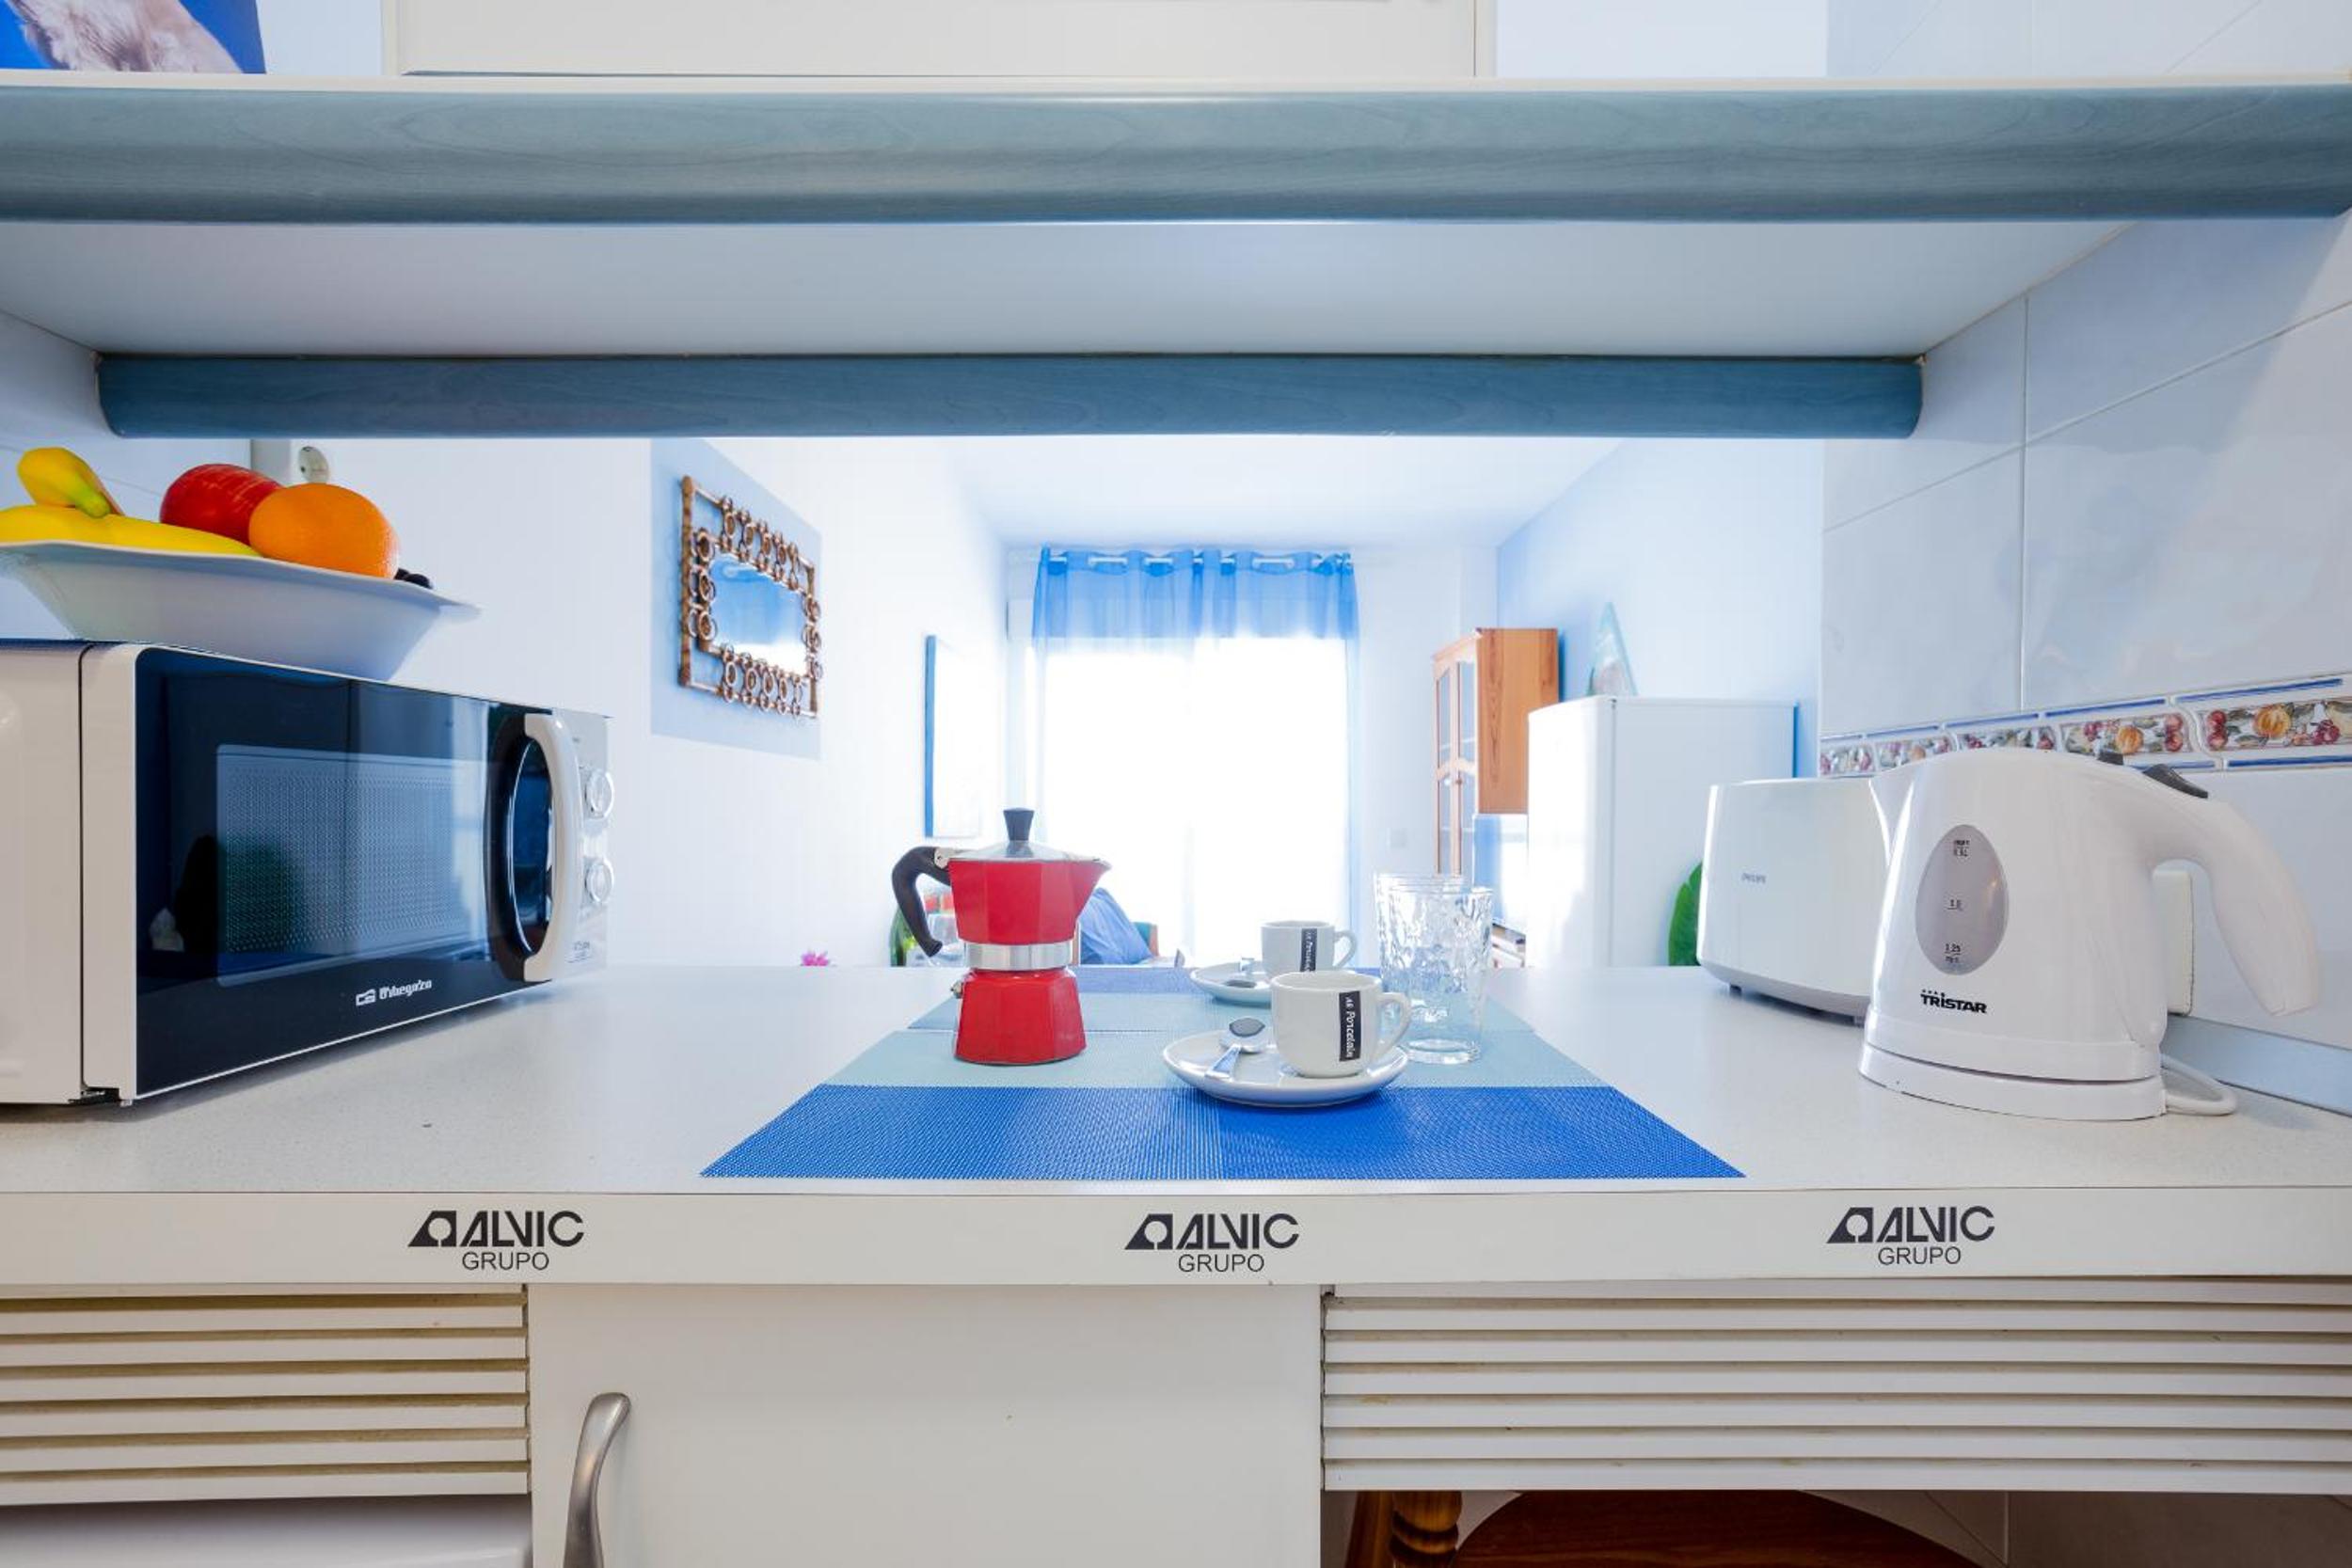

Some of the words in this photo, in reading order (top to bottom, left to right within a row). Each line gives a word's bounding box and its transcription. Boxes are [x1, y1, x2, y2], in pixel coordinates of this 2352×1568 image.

[460, 1210, 585, 1247] ALVIC
[1176, 1212, 1300, 1250] ALVIC
[1876, 1206, 1995, 1243] ALVIC
[462, 1251, 549, 1271] GRUPO
[1178, 1253, 1264, 1273] GRUPO
[1878, 1246, 1962, 1266] GRUPO
